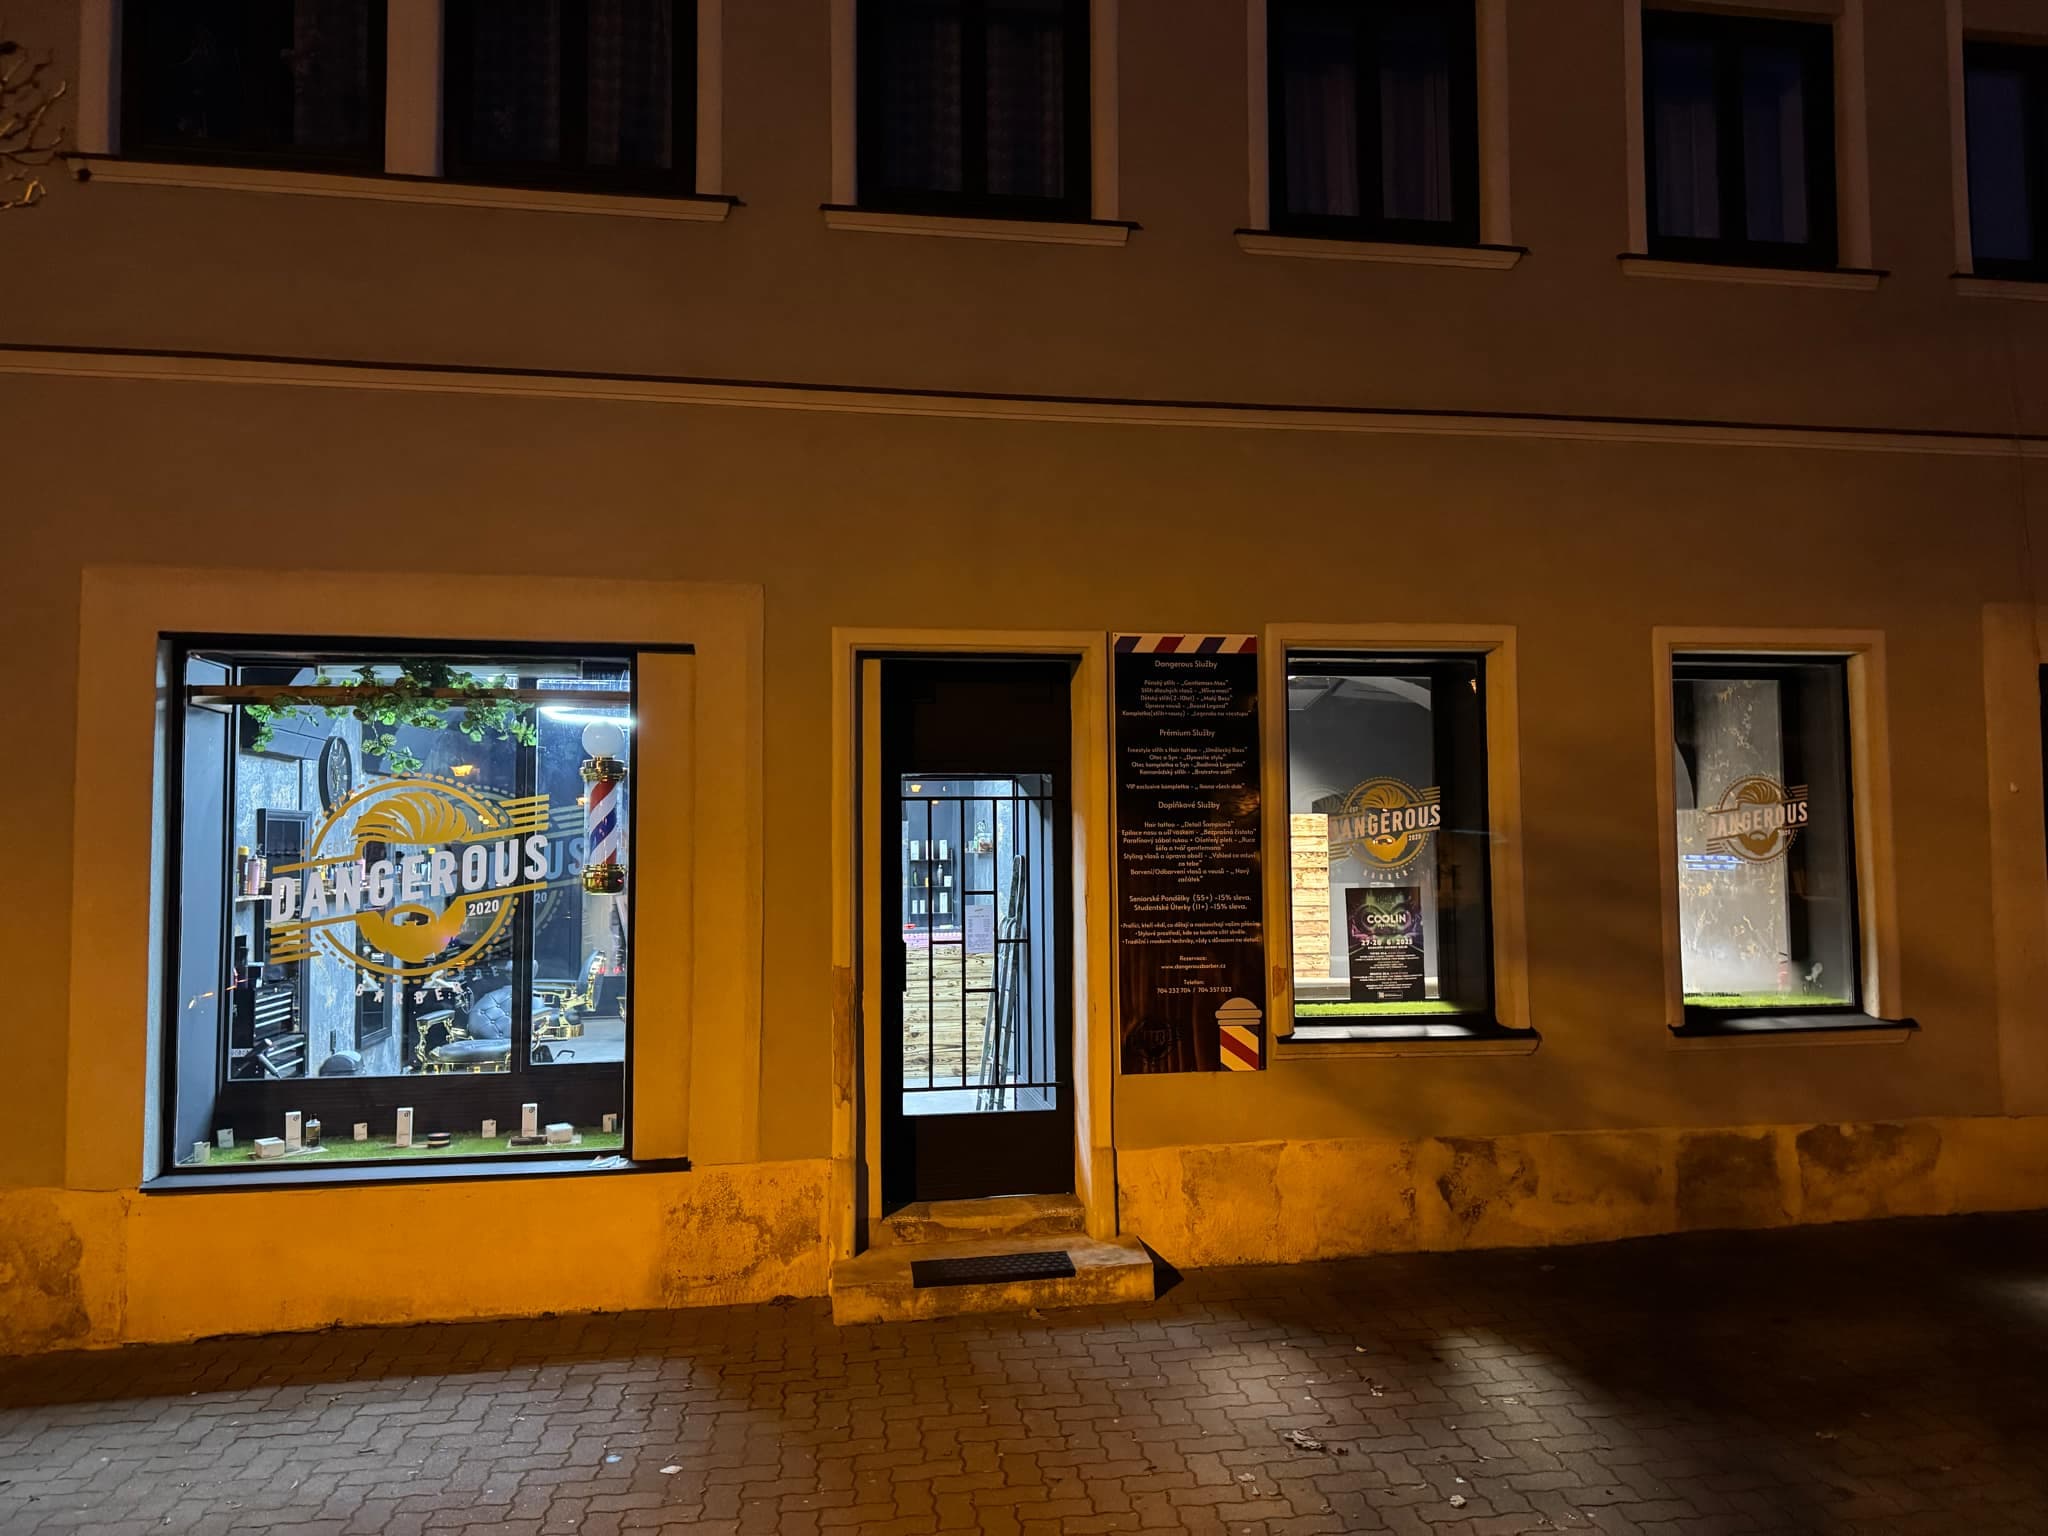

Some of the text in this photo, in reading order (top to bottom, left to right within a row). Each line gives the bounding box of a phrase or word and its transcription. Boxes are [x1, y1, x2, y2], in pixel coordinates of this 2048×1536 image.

[1154, 660, 1218, 670] Dangerous Služby
[1160, 728, 1216, 739] Prémium Služby
[1158, 800, 1220, 811] Doplňkové Služby
[1329, 804, 1441, 841] DANGEROUS
[271, 835, 549, 924] DANGEROUS
[1129, 894, 1160, 902] Seniorské
[1160, 894, 1190, 903] Pondělky
[1193, 893, 1213, 902] (55+)
[468, 899, 499, 917] 2020
[1170, 902, 1191, 912] Úterky
[1192, 902, 1209, 912] (11+)
[1366, 913, 1407, 924] COOLIN
[356, 982, 464, 1005] BARBER
